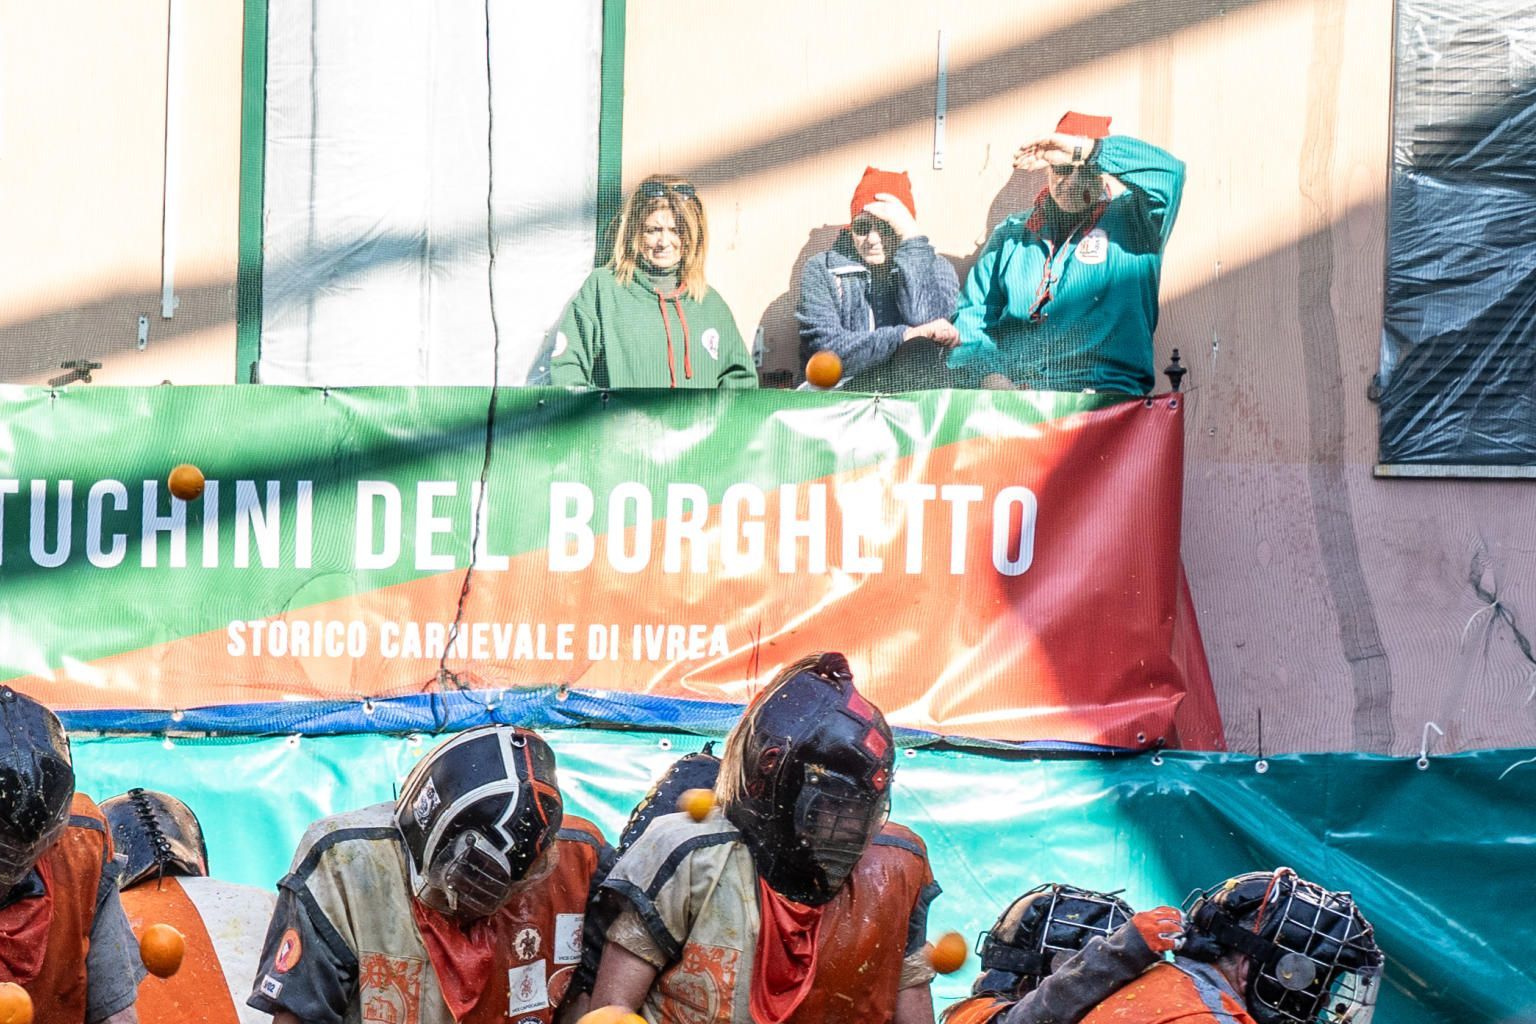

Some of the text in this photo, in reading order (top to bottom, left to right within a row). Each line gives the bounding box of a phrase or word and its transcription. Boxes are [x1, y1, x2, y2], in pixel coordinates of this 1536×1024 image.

[354, 480, 510, 573] DEL
[547, 481, 1038, 578] BORGHETTO
[226, 620, 731, 661] STORICO CARNEVALE DI IVREA
